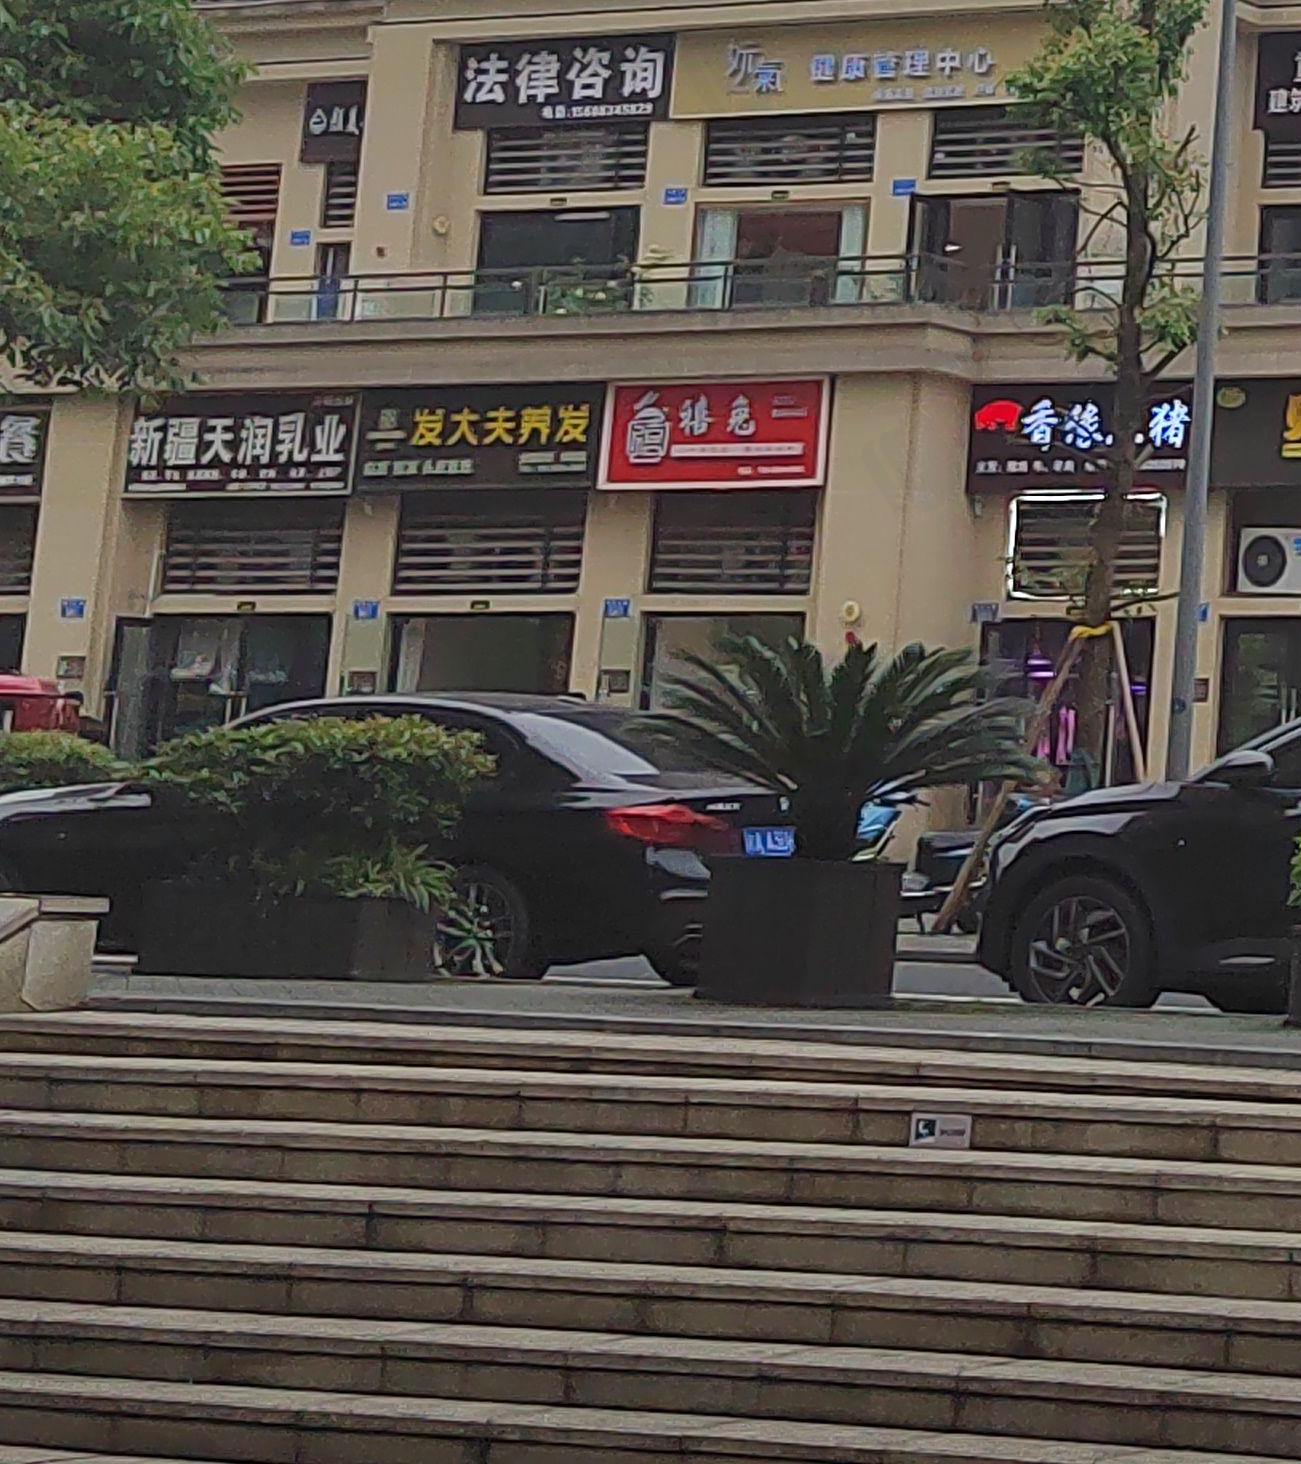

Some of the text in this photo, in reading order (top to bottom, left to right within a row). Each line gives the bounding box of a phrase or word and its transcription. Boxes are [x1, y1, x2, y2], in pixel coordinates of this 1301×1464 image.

[463, 46, 665, 104] 法律咨询
[128, 412, 347, 466] 新疆天润乳业
[408, 402, 591, 447] 发大夫养发
